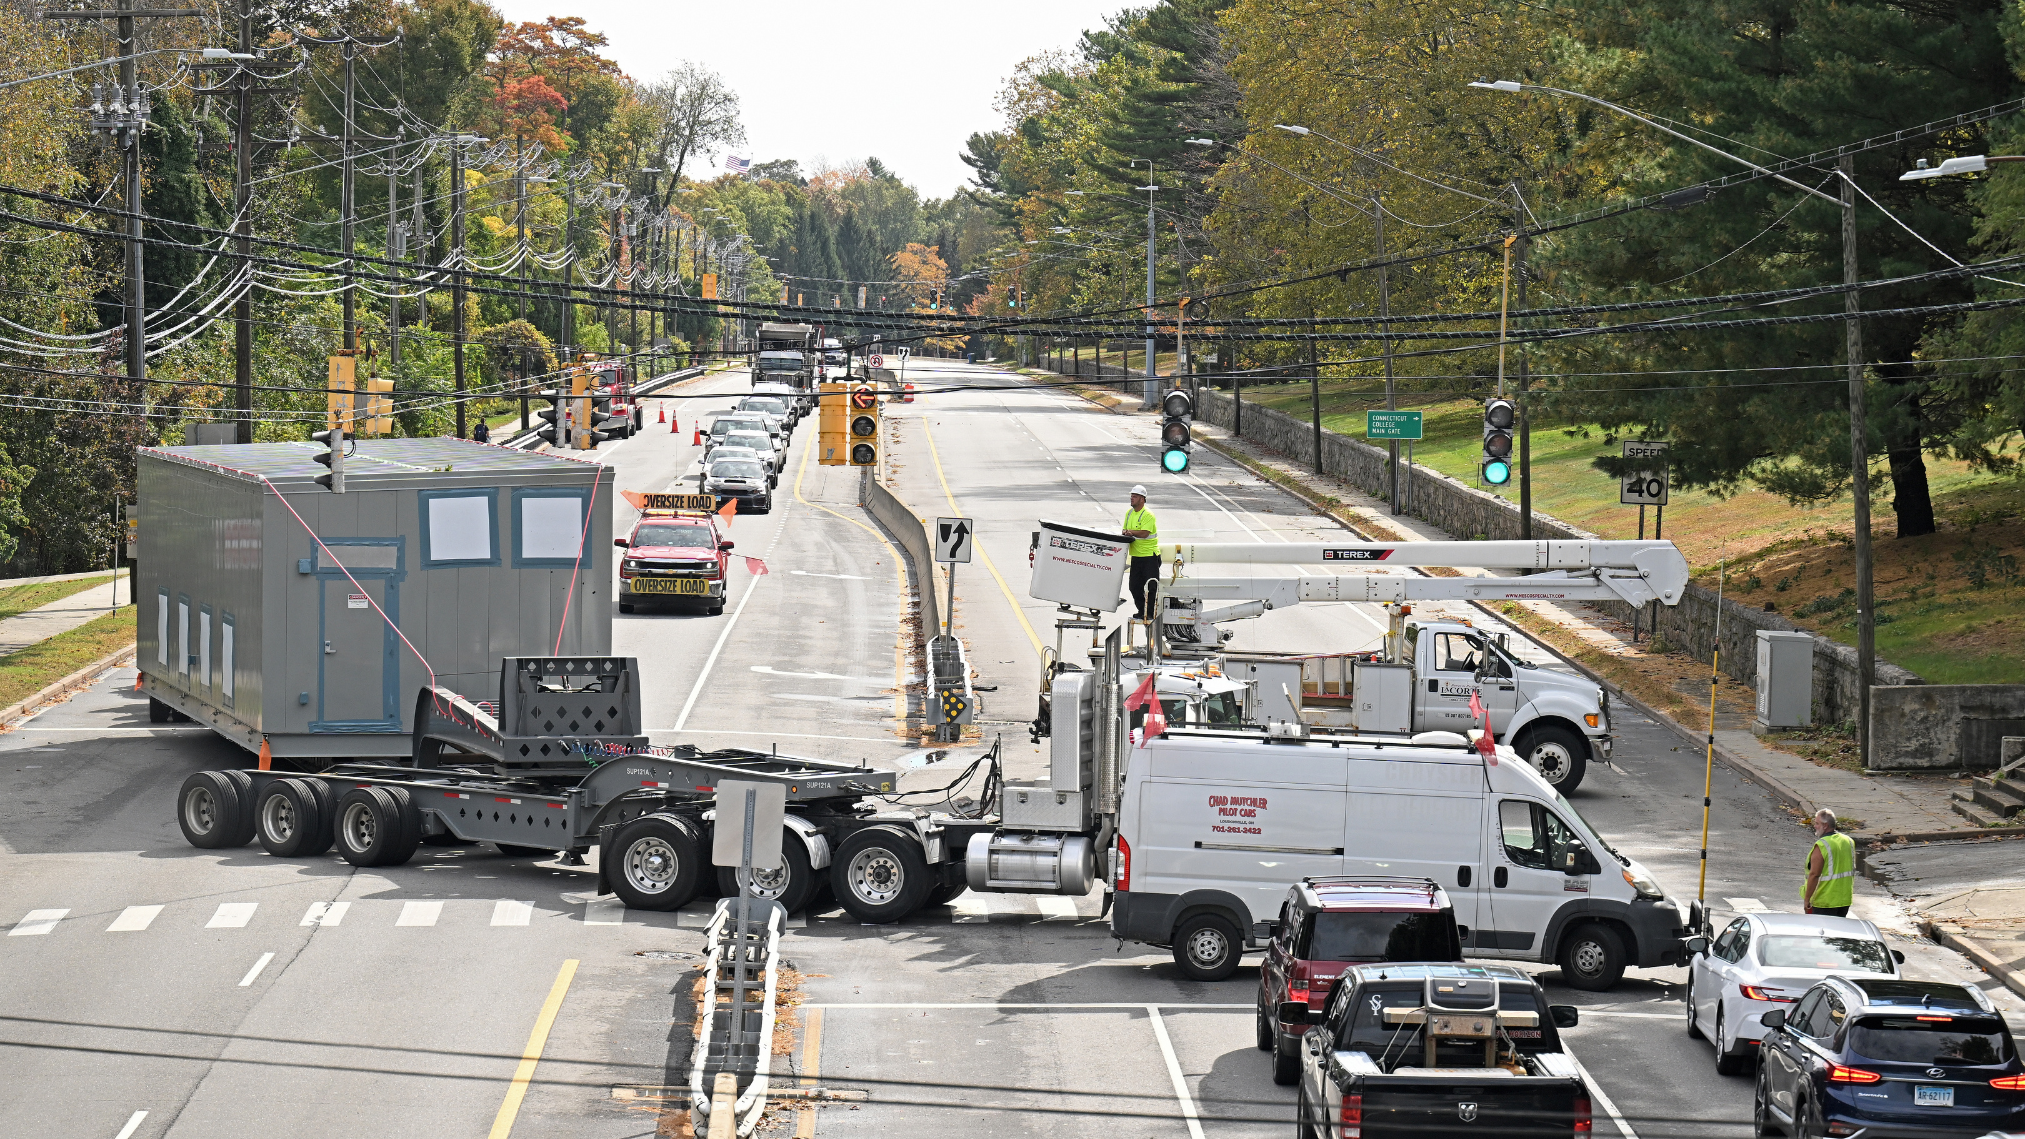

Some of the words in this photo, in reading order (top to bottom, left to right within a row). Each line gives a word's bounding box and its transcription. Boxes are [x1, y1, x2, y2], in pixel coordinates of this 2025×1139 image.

[1626, 477, 1662, 498] 40
[687, 495, 712, 510] LOAD
[634, 578, 678, 593] OVERSIZE
[680, 579, 706, 594] LOAD
[626, 767, 650, 776] SUP121A
[806, 781, 832, 790] SUP121A
[1208, 795, 1228, 808] CHAD
[1230, 796, 1268, 810] MUTCHLER
[1218, 807, 1238, 816] PILOT
[1239, 808, 1256, 818] CARS
